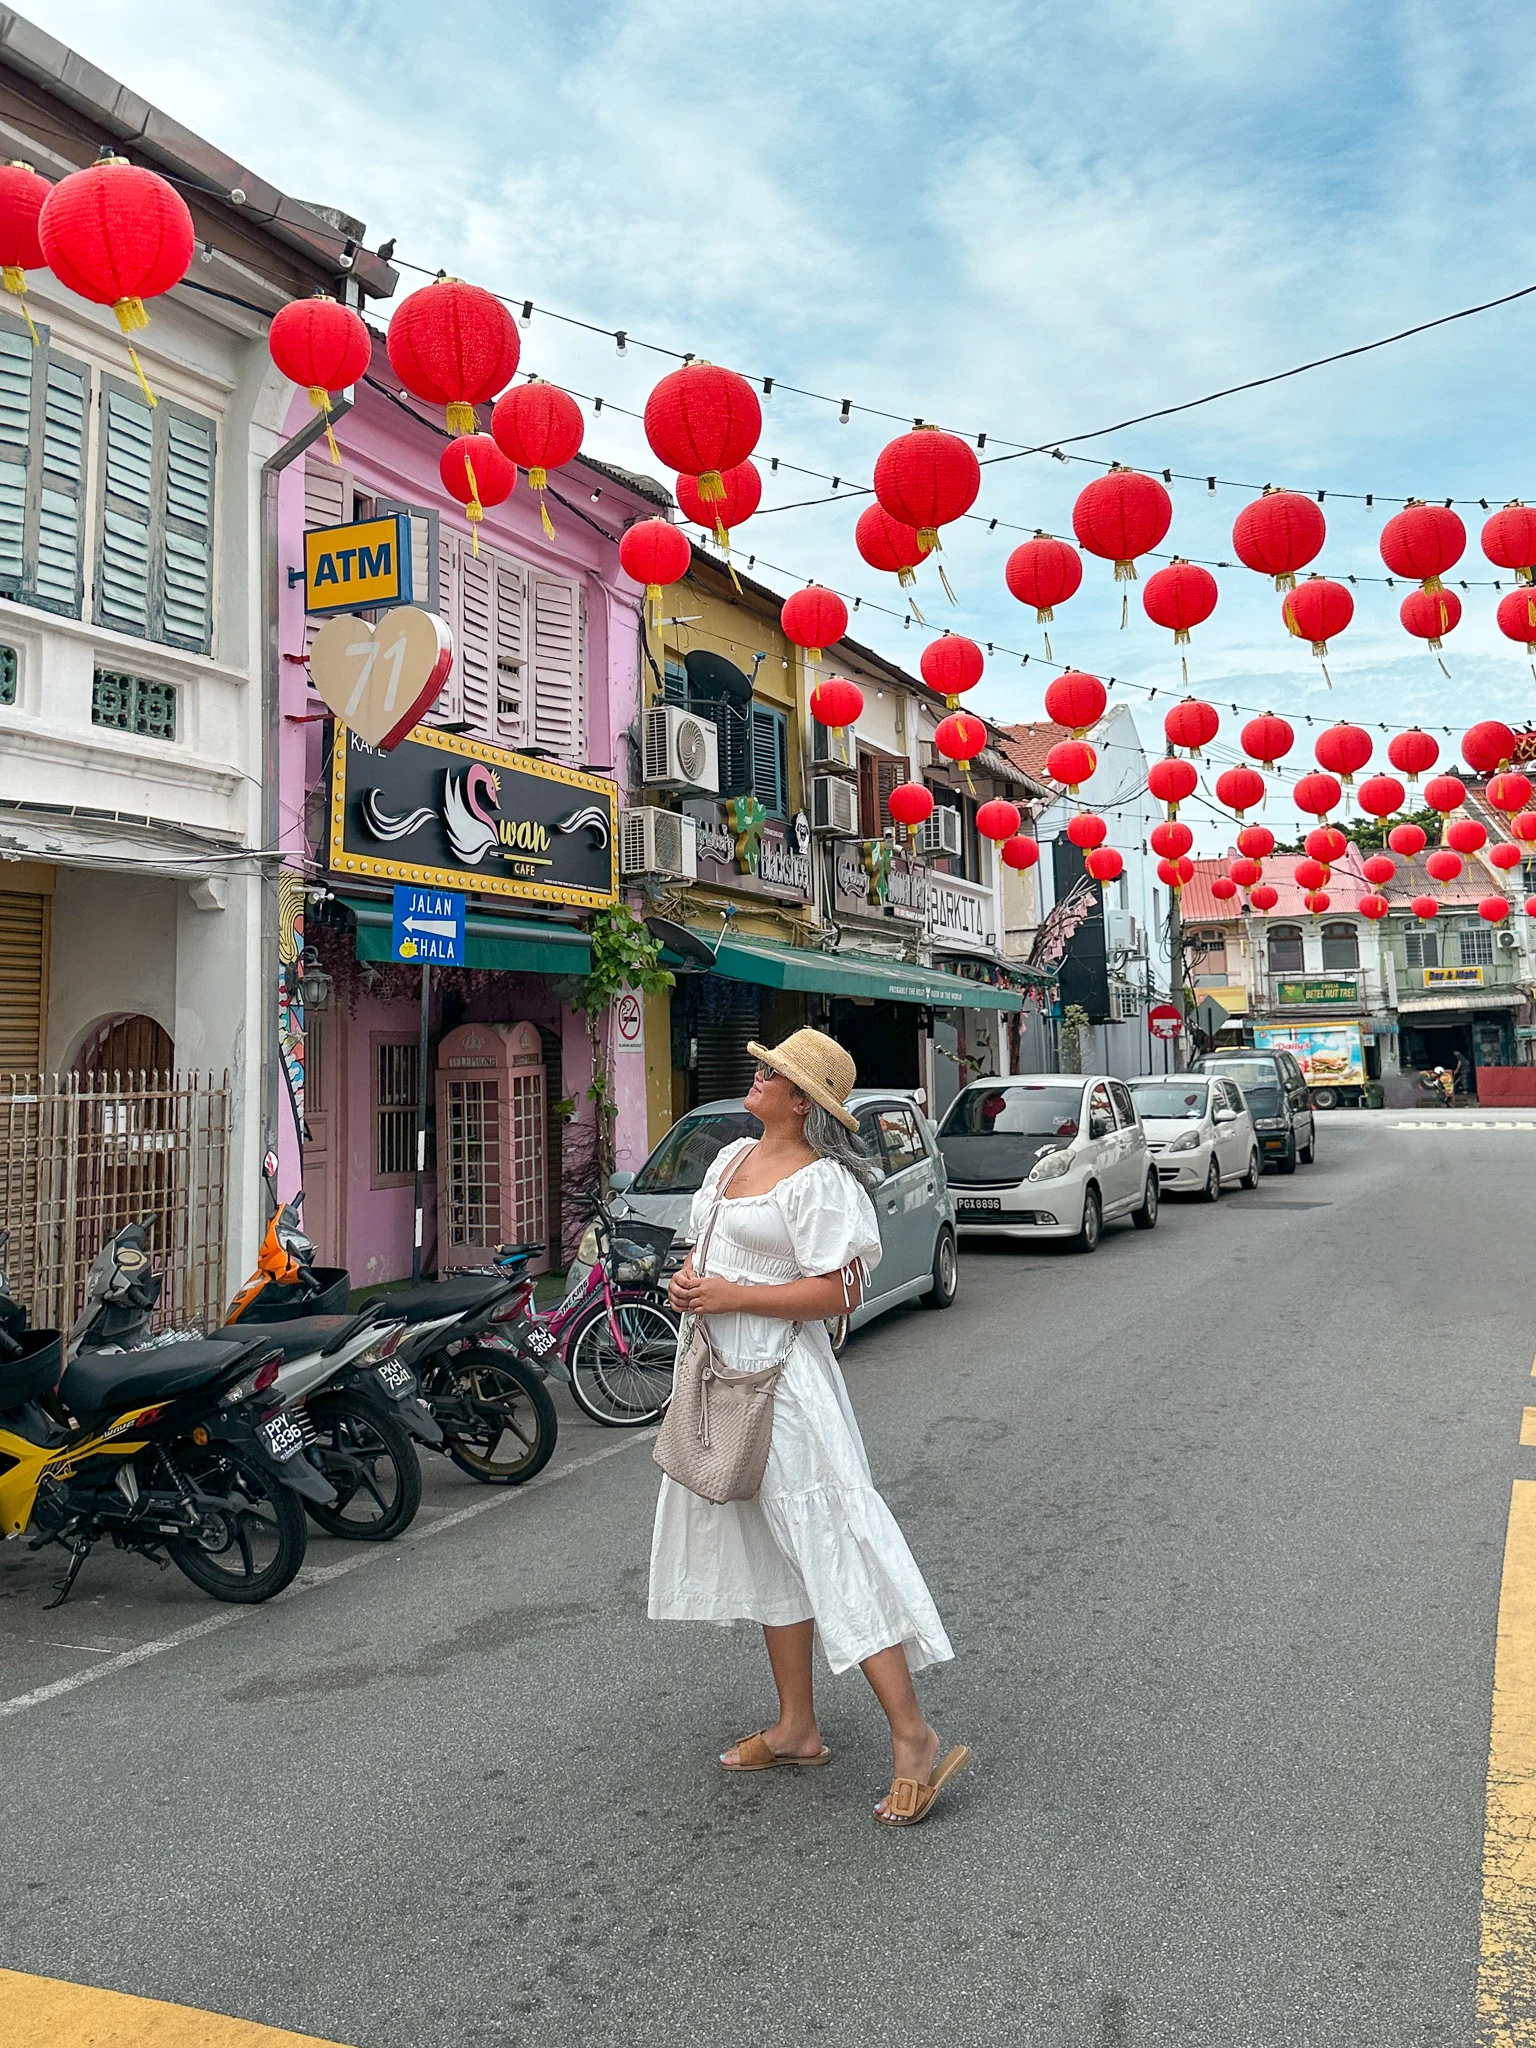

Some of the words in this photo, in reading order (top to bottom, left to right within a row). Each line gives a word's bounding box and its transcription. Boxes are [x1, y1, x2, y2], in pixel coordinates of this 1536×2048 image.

[313, 542, 392, 587] ATM
[345, 634, 408, 716] 71
[514, 862, 535, 877] CAFE
[408, 893, 452, 916] JALAN
[931, 887, 983, 936] BARKITA
[1429, 970, 1444, 980] Day
[1456, 969, 1478, 979] Night
[1305, 989, 1324, 999] BETEL
[1325, 988, 1339, 999] NUT
[1340, 987, 1355, 998] TREE
[1274, 1040, 1311, 1052] Daily's
[527, 1326, 547, 1346] PKJ
[533, 1333, 557, 1356] 3034
[377, 1358, 403, 1380] PKH
[385, 1368, 411, 1390] 7941
[264, 1412, 289, 1439] PPY
[271, 1423, 302, 1454] 4336
